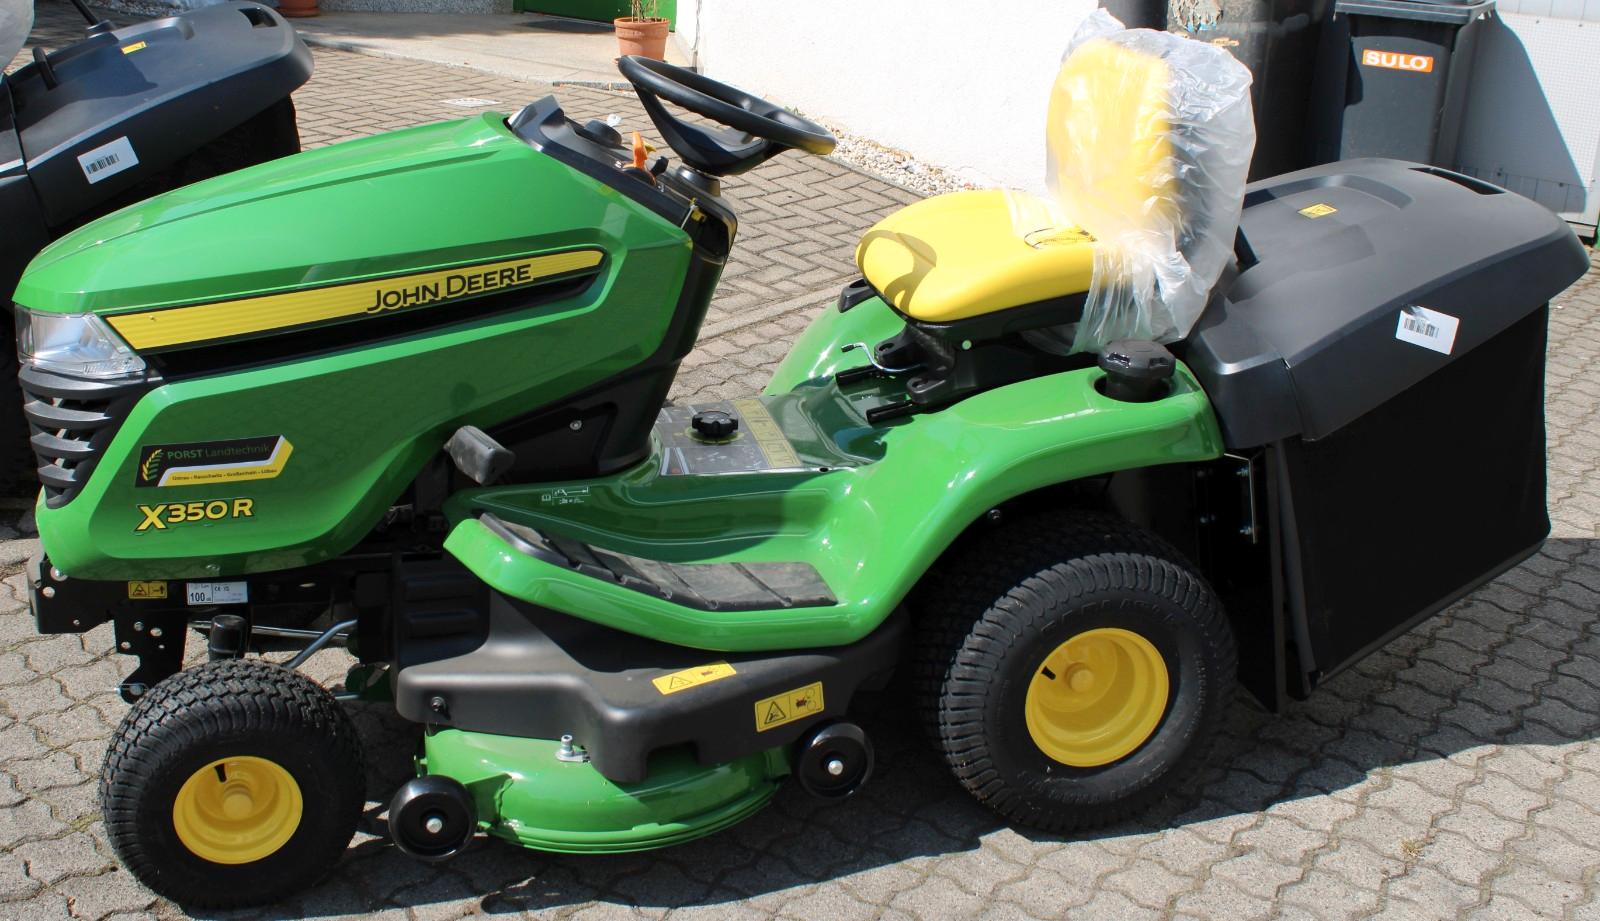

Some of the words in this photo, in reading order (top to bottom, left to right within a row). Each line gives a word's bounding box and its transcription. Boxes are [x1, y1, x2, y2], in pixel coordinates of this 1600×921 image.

[1366, 51, 1428, 69] SULO
[367, 282, 440, 312] JOHN
[446, 264, 532, 297] DEERE
[167, 449, 203, 460] PORST
[205, 443, 270, 457] Landtechnik
[135, 500, 229, 532] X350
[232, 498, 255, 519] R
[190, 592, 205, 602] 100
